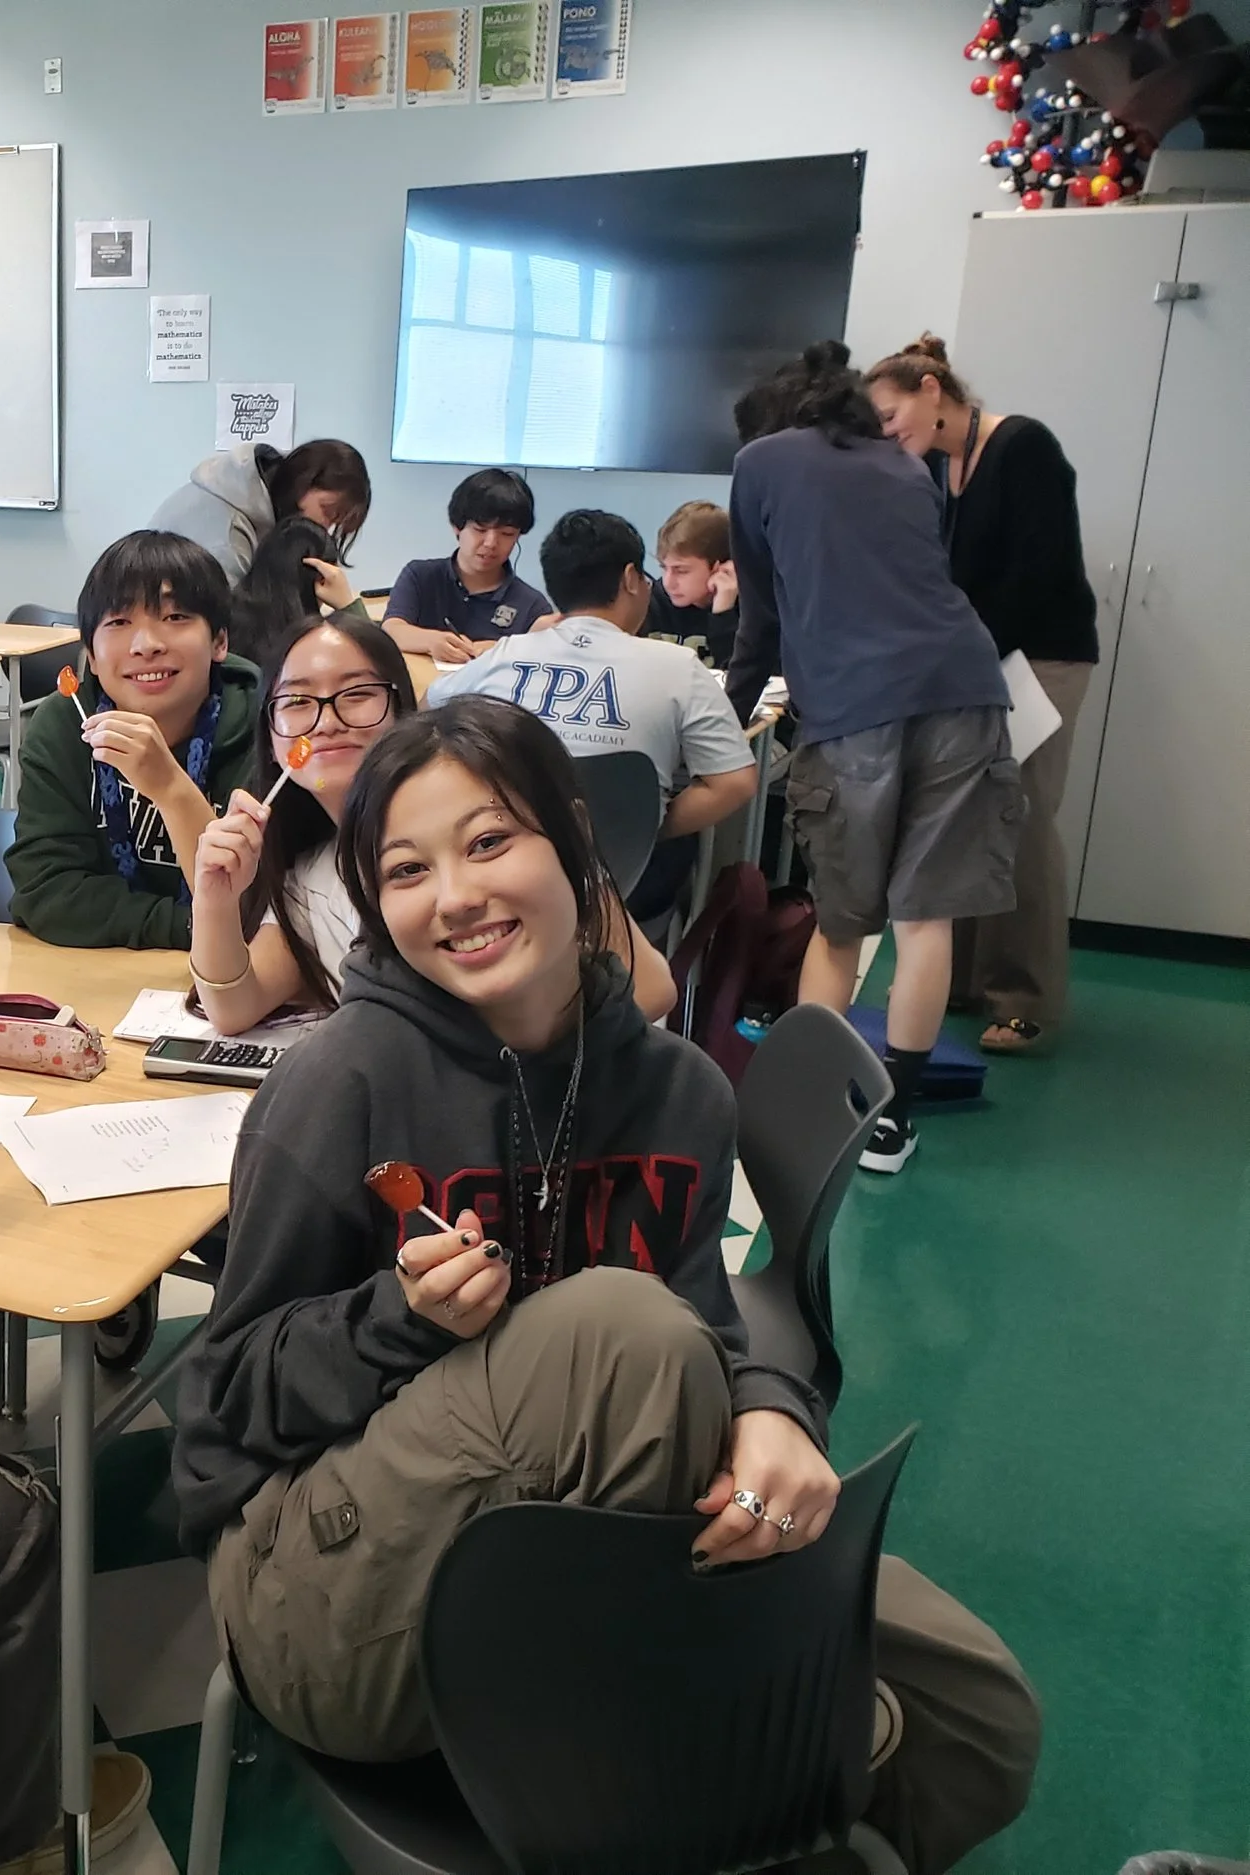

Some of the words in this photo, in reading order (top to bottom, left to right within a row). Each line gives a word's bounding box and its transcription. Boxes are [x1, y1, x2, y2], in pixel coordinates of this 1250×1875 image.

[563, 5, 597, 19] PONO
[268, 30, 301, 44] ALOHA
[157, 309, 171, 317] The
[173, 308, 187, 318] only
[189, 309, 202, 317] way
[231, 417, 269, 441] happen
[513, 661, 630, 730] IPA
[571, 731, 625, 746] ACADEMY
